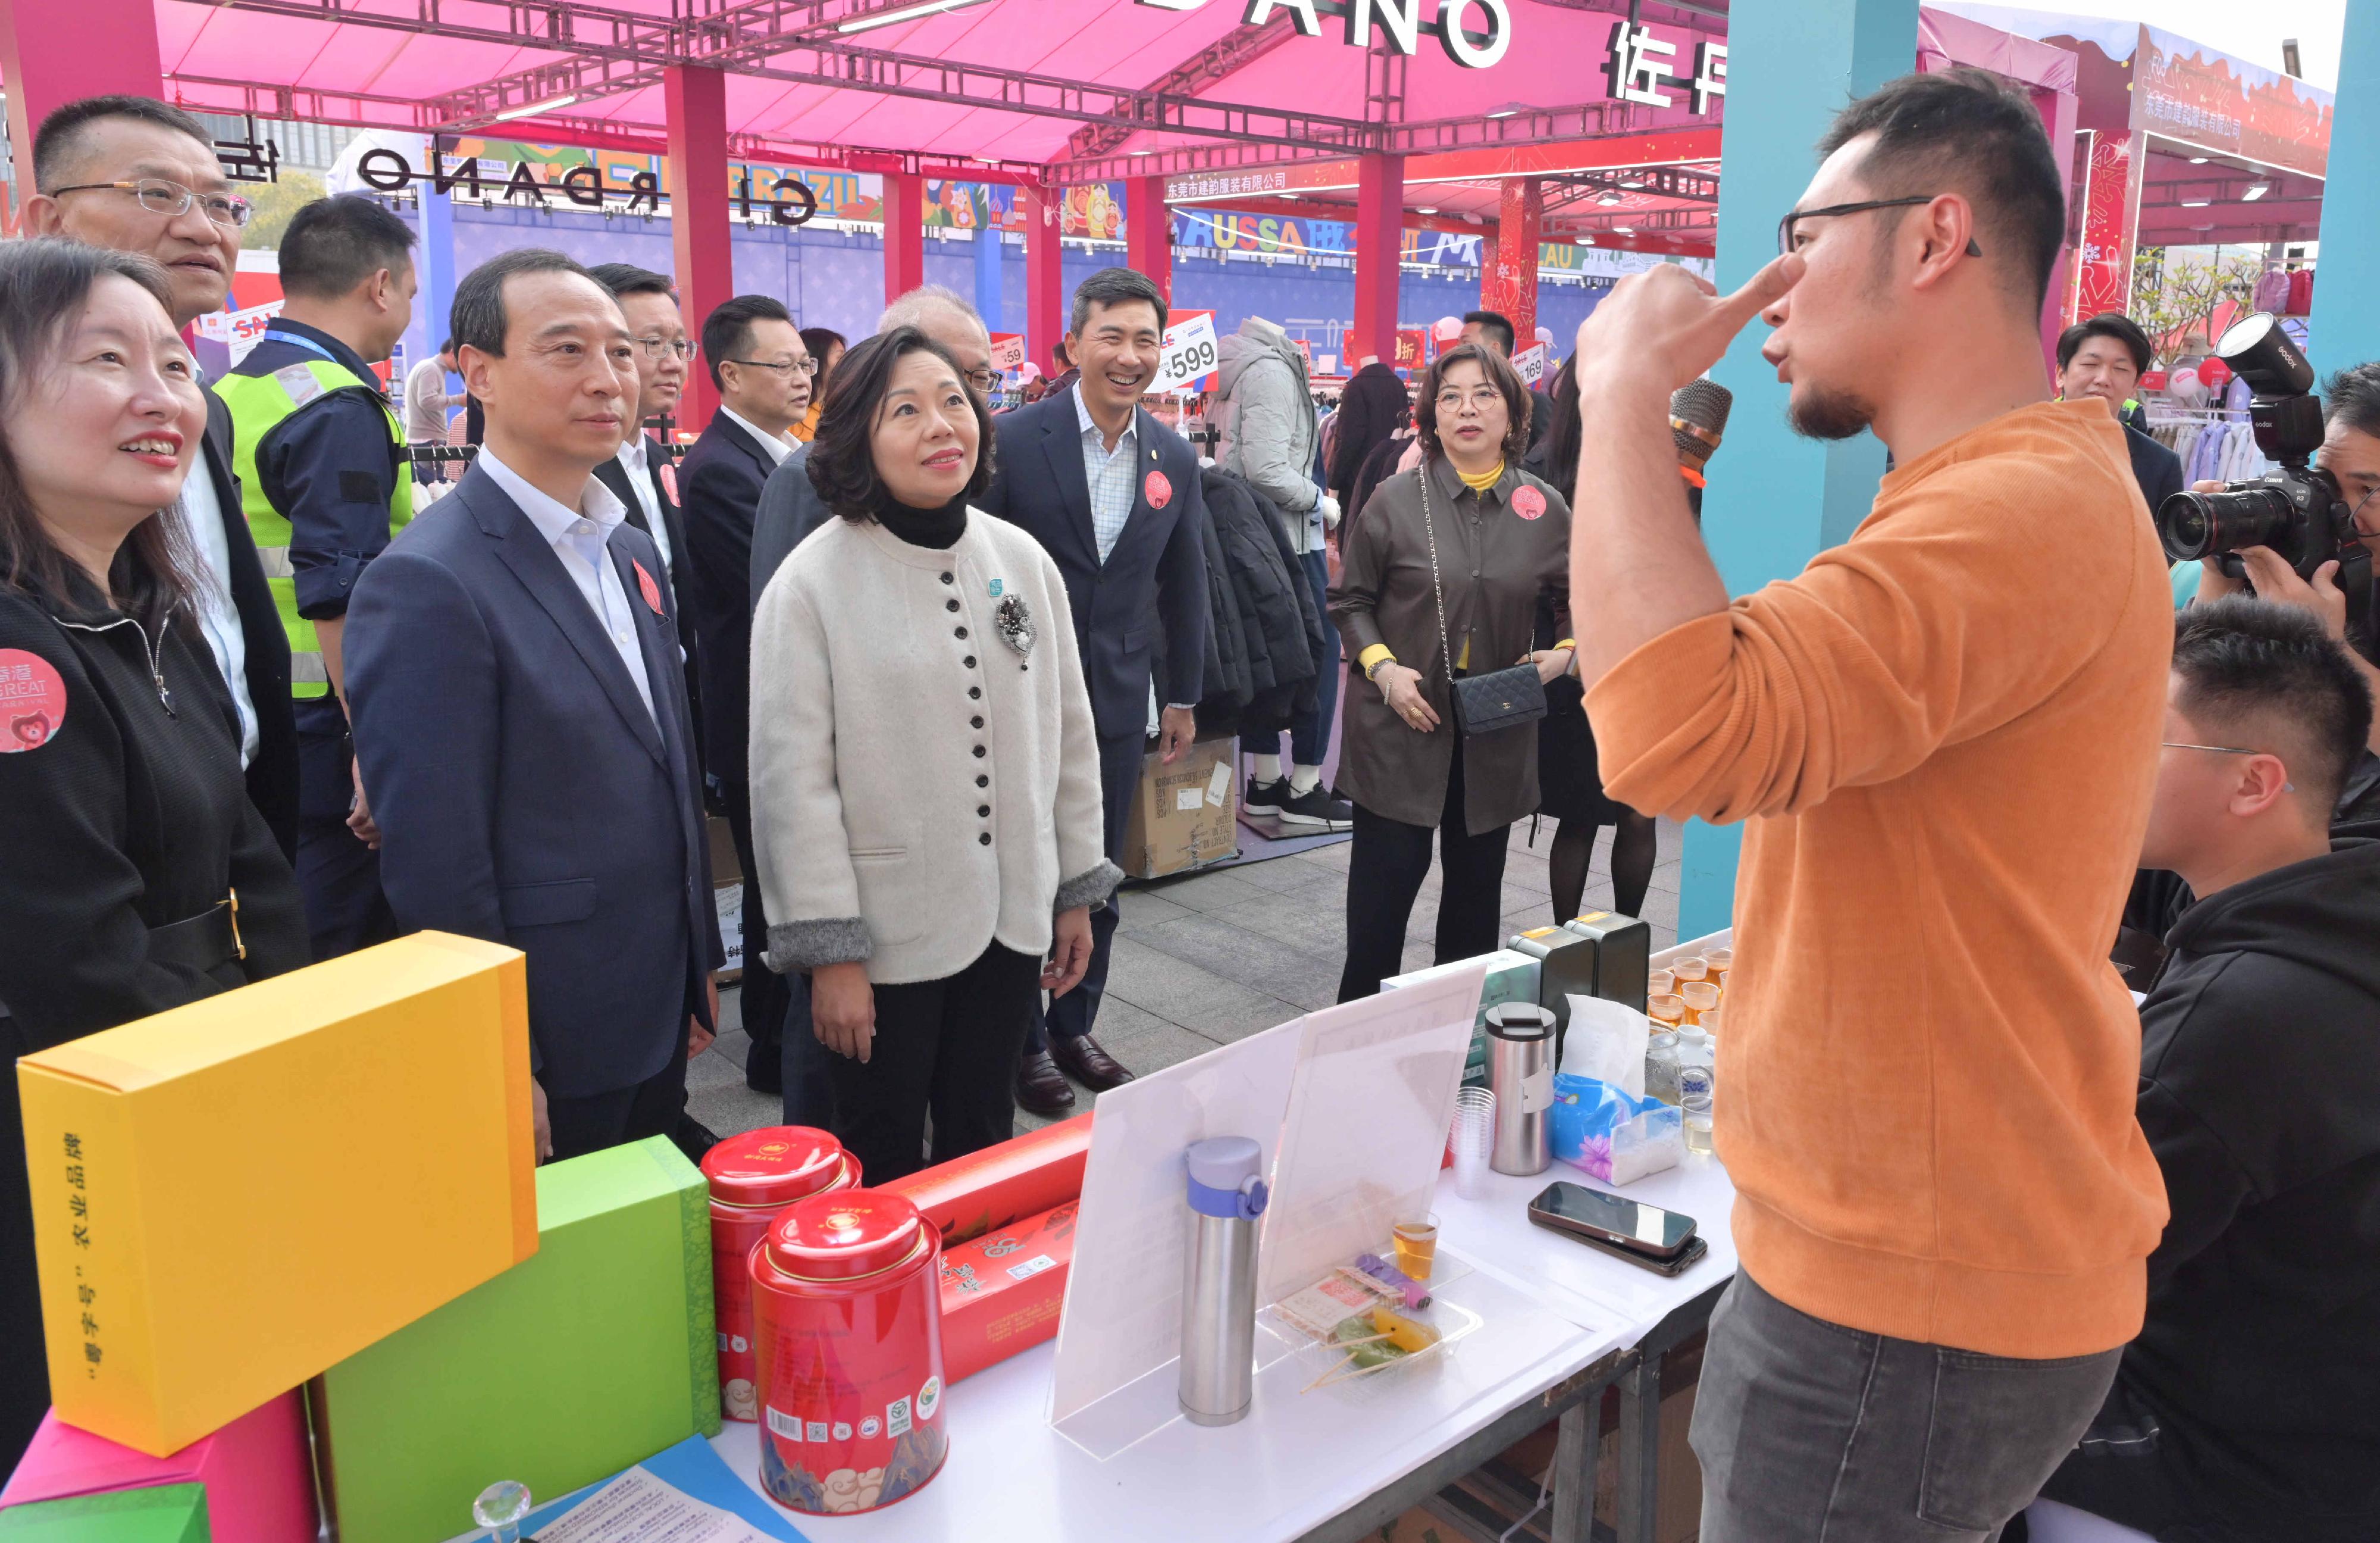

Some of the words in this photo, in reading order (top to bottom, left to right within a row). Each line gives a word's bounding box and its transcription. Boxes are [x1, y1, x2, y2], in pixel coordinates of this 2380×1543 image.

[1168, 173, 1285, 198] 东莞市建韵服装有限公司
[1182, 211, 1307, 255] RUSSA
[1165, 341, 1214, 378] ¥599
[2278, 346, 2297, 369] Godox
[0, 680, 46, 697] REAT
